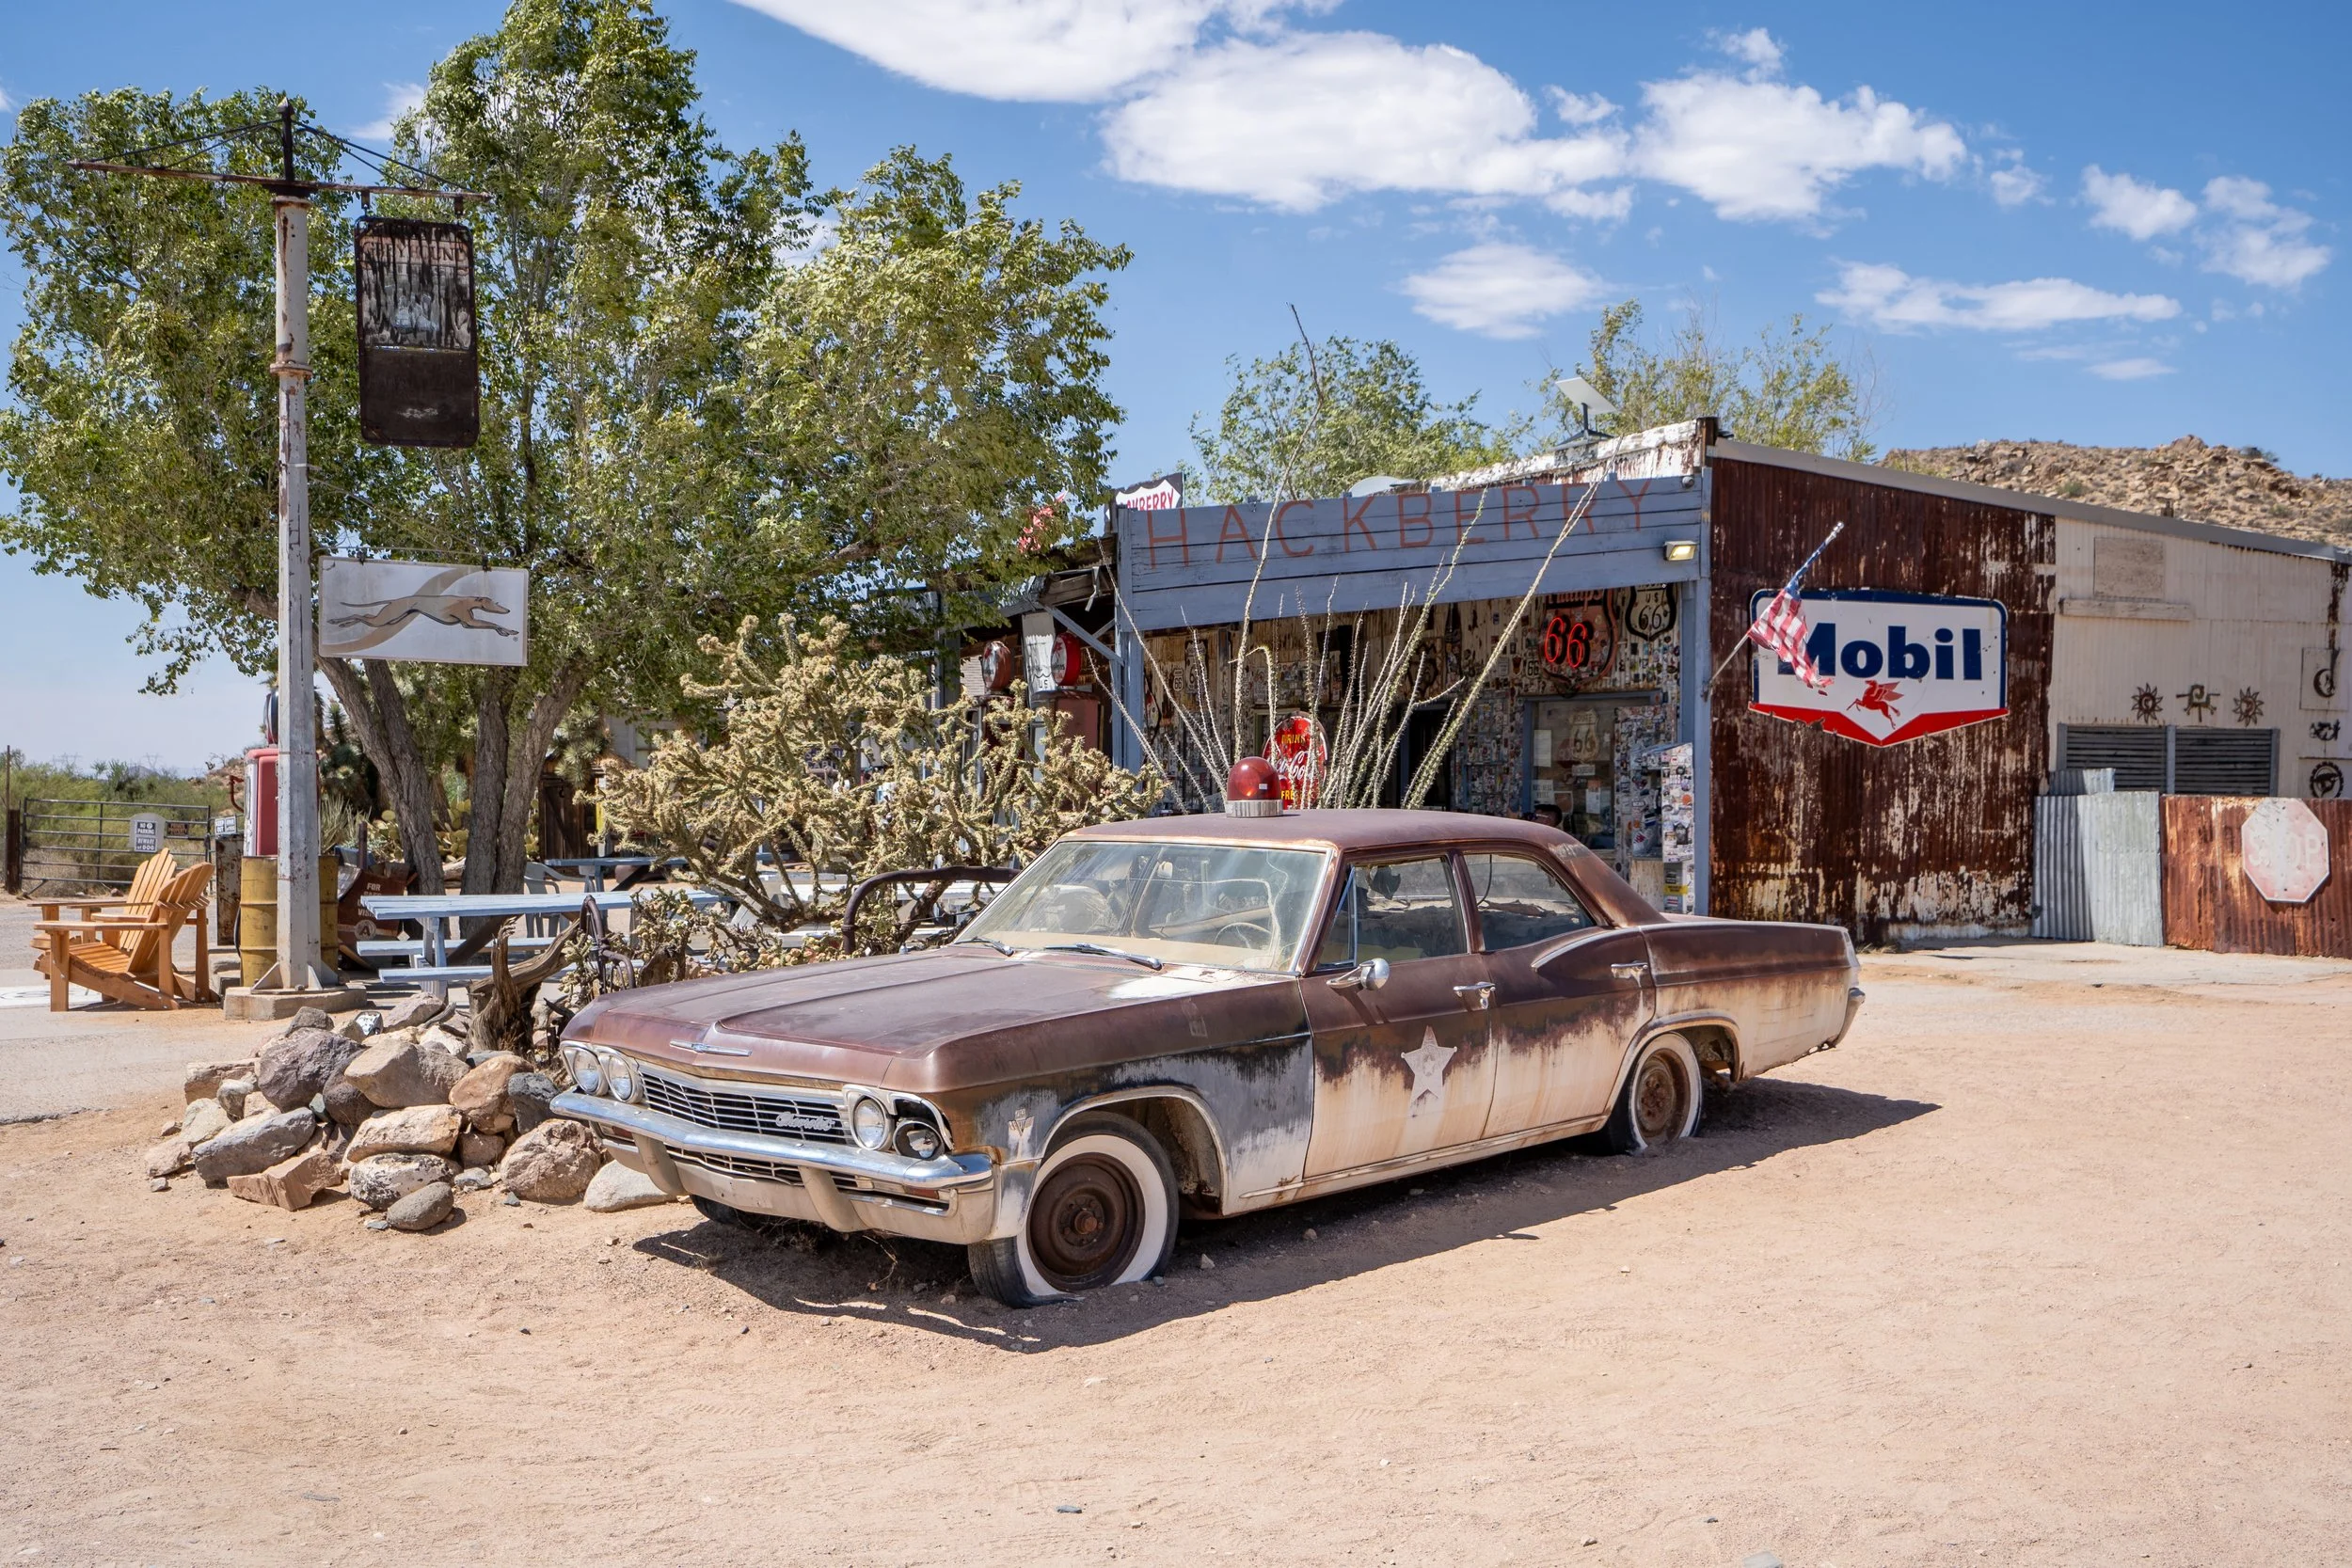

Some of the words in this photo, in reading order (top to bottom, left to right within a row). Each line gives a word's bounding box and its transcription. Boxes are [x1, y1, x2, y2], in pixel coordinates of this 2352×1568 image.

[1146, 478, 1653, 570] HACKBERRY
[1638, 604, 1662, 630] 66
[1544, 616, 1588, 670] 66
[367, 882, 381, 892] FOR
[775, 1111, 836, 1132] Chevrolet
